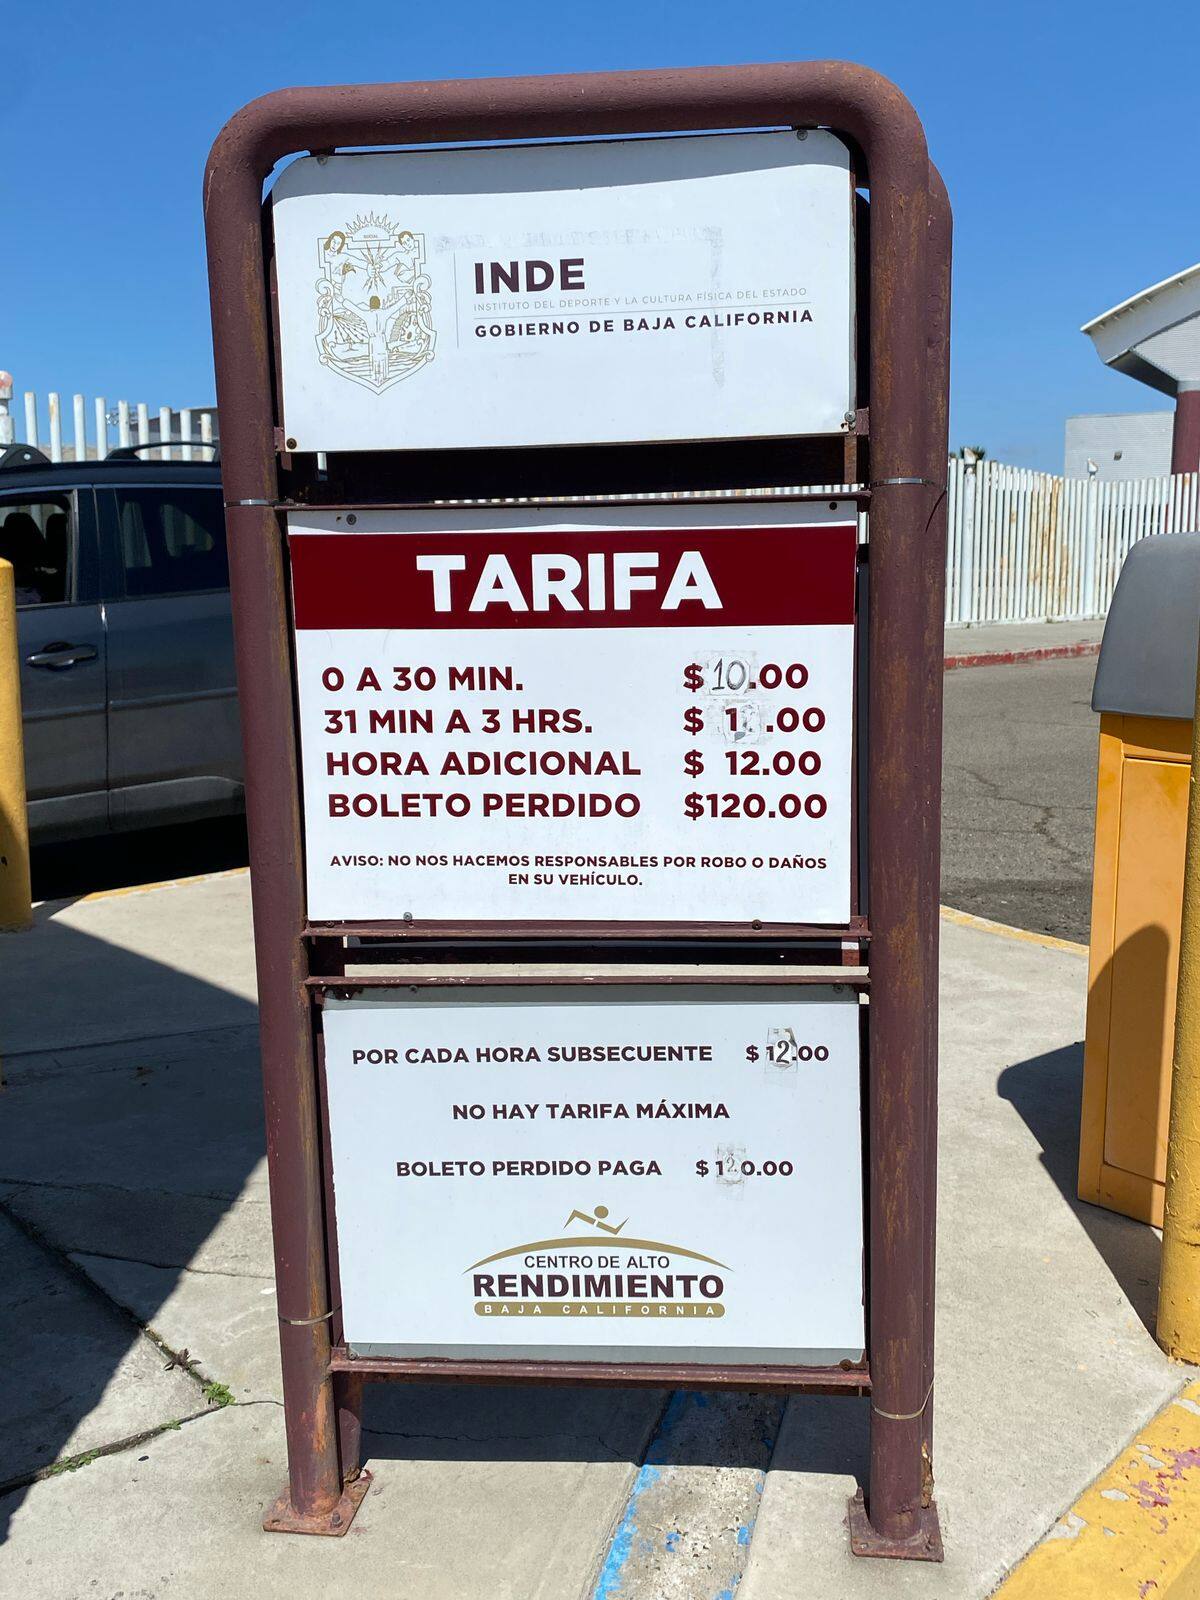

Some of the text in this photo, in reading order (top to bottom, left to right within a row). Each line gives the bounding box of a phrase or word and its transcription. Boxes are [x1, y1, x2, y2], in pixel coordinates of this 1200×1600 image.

[475, 258, 585, 294] INDE
[474, 301, 529, 311] INSTITUTO
[533, 300, 555, 311] DEL
[560, 298, 609, 307] DEPORTE
[614, 298, 622, 307] Y
[642, 294, 692, 304] CULTURA
[697, 290, 733, 302] FÍSICA
[737, 291, 758, 300] DEL
[763, 288, 806, 297] ESTADO
[475, 310, 812, 337] GOBIERNO DE BAJA CALIFORNIA
[416, 551, 723, 611] TARIFA
[357, 667, 382, 691] A
[393, 667, 436, 691] 30
[449, 667, 523, 690] MIN.
[325, 710, 356, 734] 31
[369, 710, 433, 733] MIN
[445, 710, 471, 733] A
[482, 709, 500, 733] 3
[513, 709, 592, 733] HRS.
[327, 752, 429, 776] HORA
[440, 751, 641, 775] ADICIONAL
[329, 792, 827, 820] BOLETO PERDIDO $120.00
[330, 855, 826, 869] AVISO: NO NOS HACEMOS RESPONSABLES POR ROBO O DAÑOS
[509, 871, 642, 885] EN SU VEHÍCULO.
[353, 1049, 398, 1064] POR
[405, 1048, 469, 1063] CADA
[476, 1047, 541, 1062] HORA
[548, 1046, 712, 1062] SUBSECUENTE
[453, 1099, 730, 1119] NO HAY TARIFA MÁXIMA
[397, 1161, 485, 1176] BOLETO
[493, 1161, 591, 1175] PERDIDO
[599, 1161, 662, 1175] PAGA
[525, 1256, 669, 1268] CENTRO DE ALTO
[474, 1275, 723, 1298] RENDIMIENTO
[485, 1305, 714, 1314] BAJA CALIFORNIA
